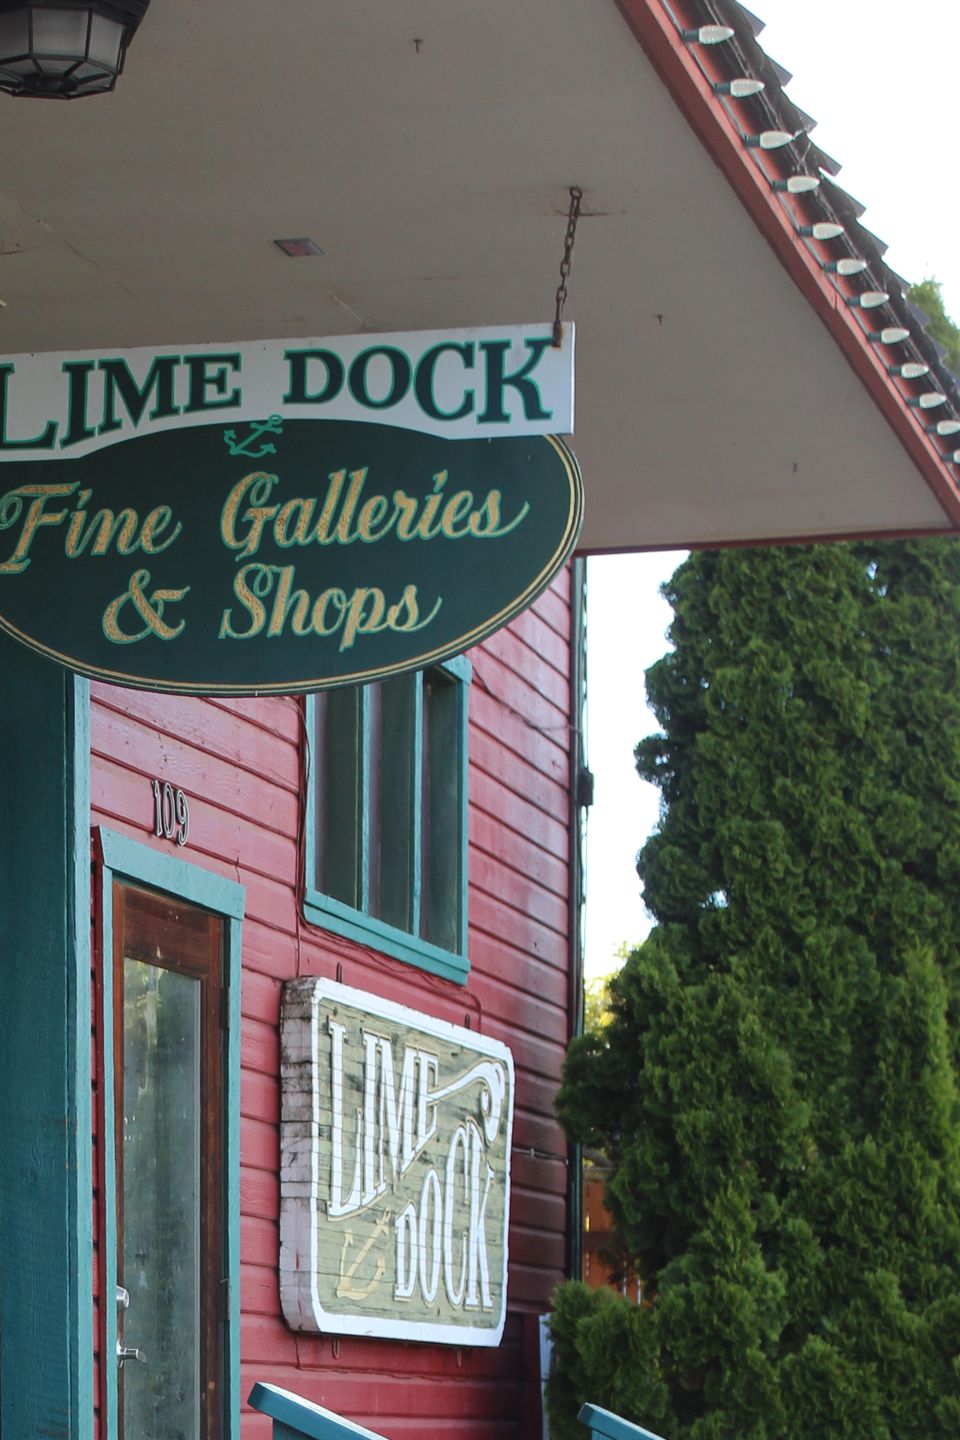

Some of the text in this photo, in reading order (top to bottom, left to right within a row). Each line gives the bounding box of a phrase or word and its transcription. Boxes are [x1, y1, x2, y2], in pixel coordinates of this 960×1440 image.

[282, 336, 555, 424] DOCK
[220, 468, 530, 563] Galleries
[101, 562, 443, 652] & Shops
[151, 779, 190, 847] 109
[327, 1015, 440, 1221] LIME
[394, 1117, 494, 1312] DOCK
